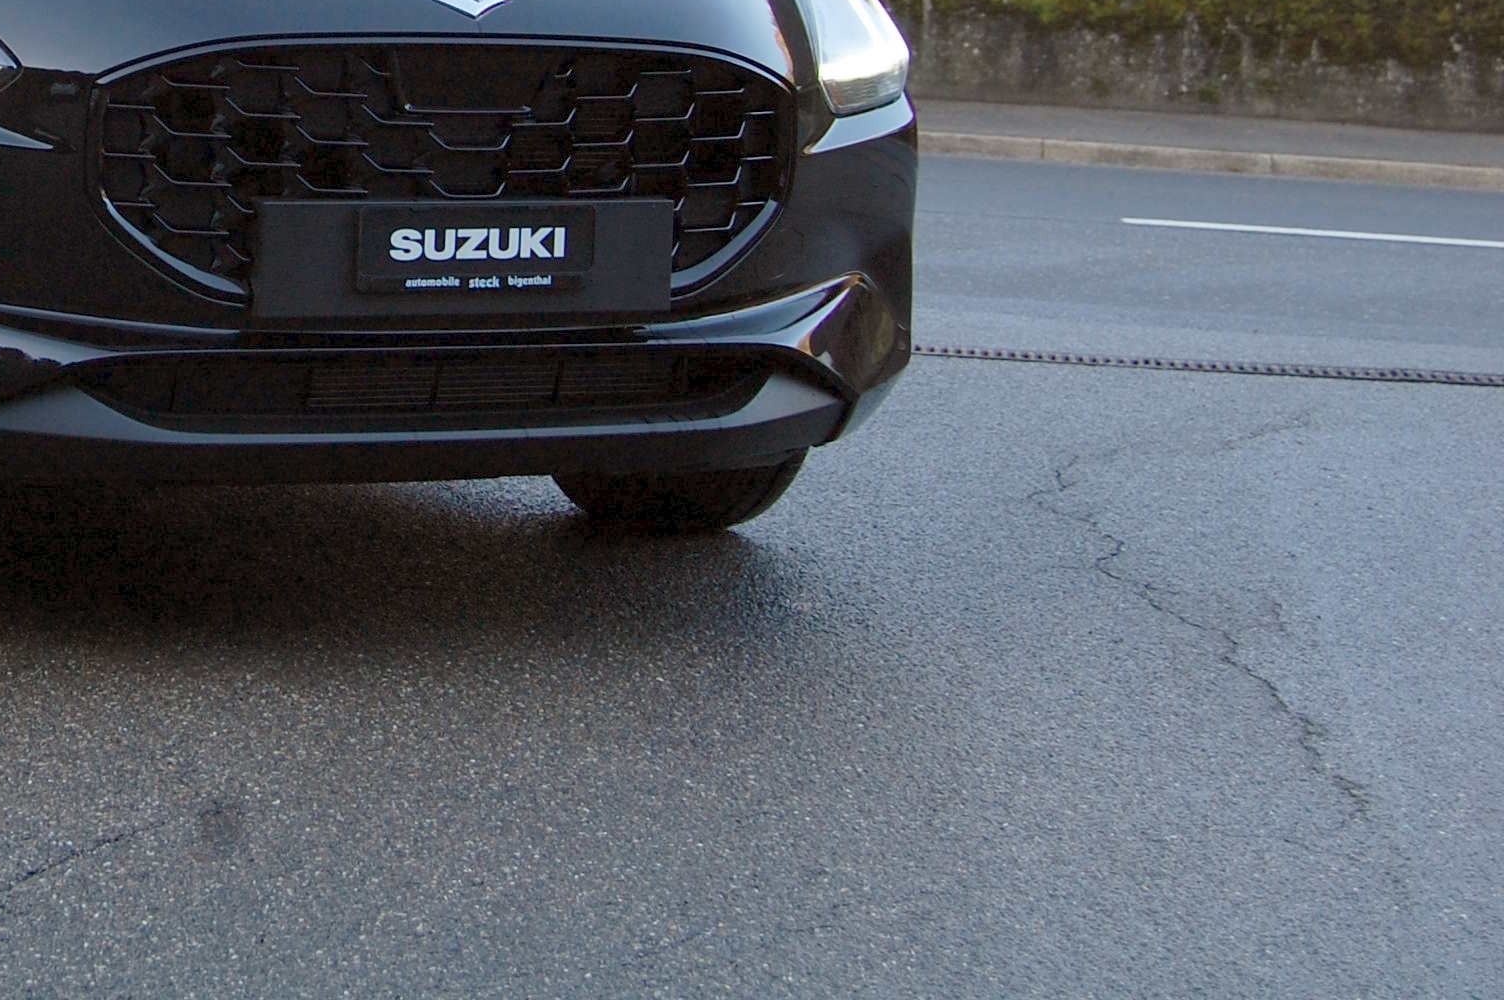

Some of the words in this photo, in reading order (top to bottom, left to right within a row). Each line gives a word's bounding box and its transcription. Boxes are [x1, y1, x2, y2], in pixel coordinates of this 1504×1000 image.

[389, 226, 566, 261] SUZUKI
[405, 276, 461, 288] automobile
[468, 275, 500, 289] steck
[507, 274, 552, 288] bigenthal
